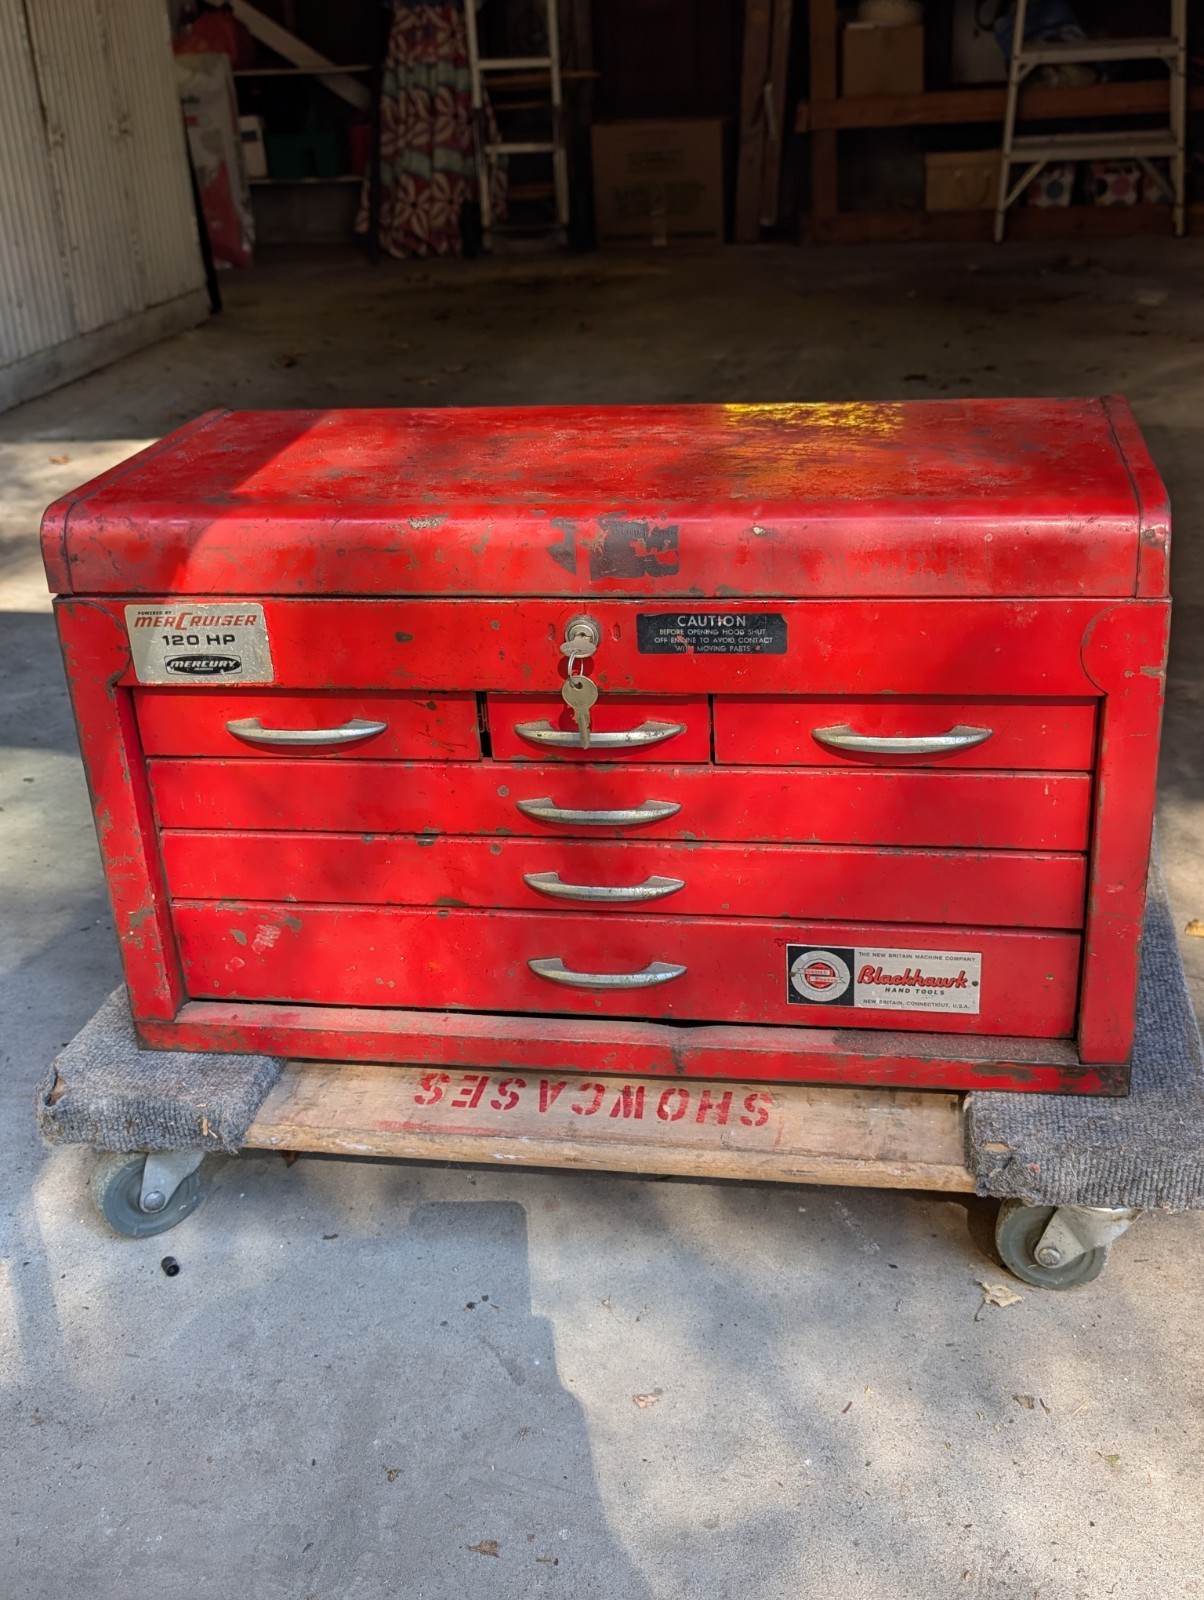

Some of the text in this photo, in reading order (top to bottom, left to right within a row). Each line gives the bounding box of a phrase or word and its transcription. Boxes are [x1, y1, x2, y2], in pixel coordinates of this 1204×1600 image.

[677, 616, 746, 627] CAUTION
[162, 634, 236, 646] 120 HP
[169, 660, 237, 668] MERCURY
[856, 965, 968, 989] Blackhawk
[414, 1072, 774, 1126] SHOWCASES
